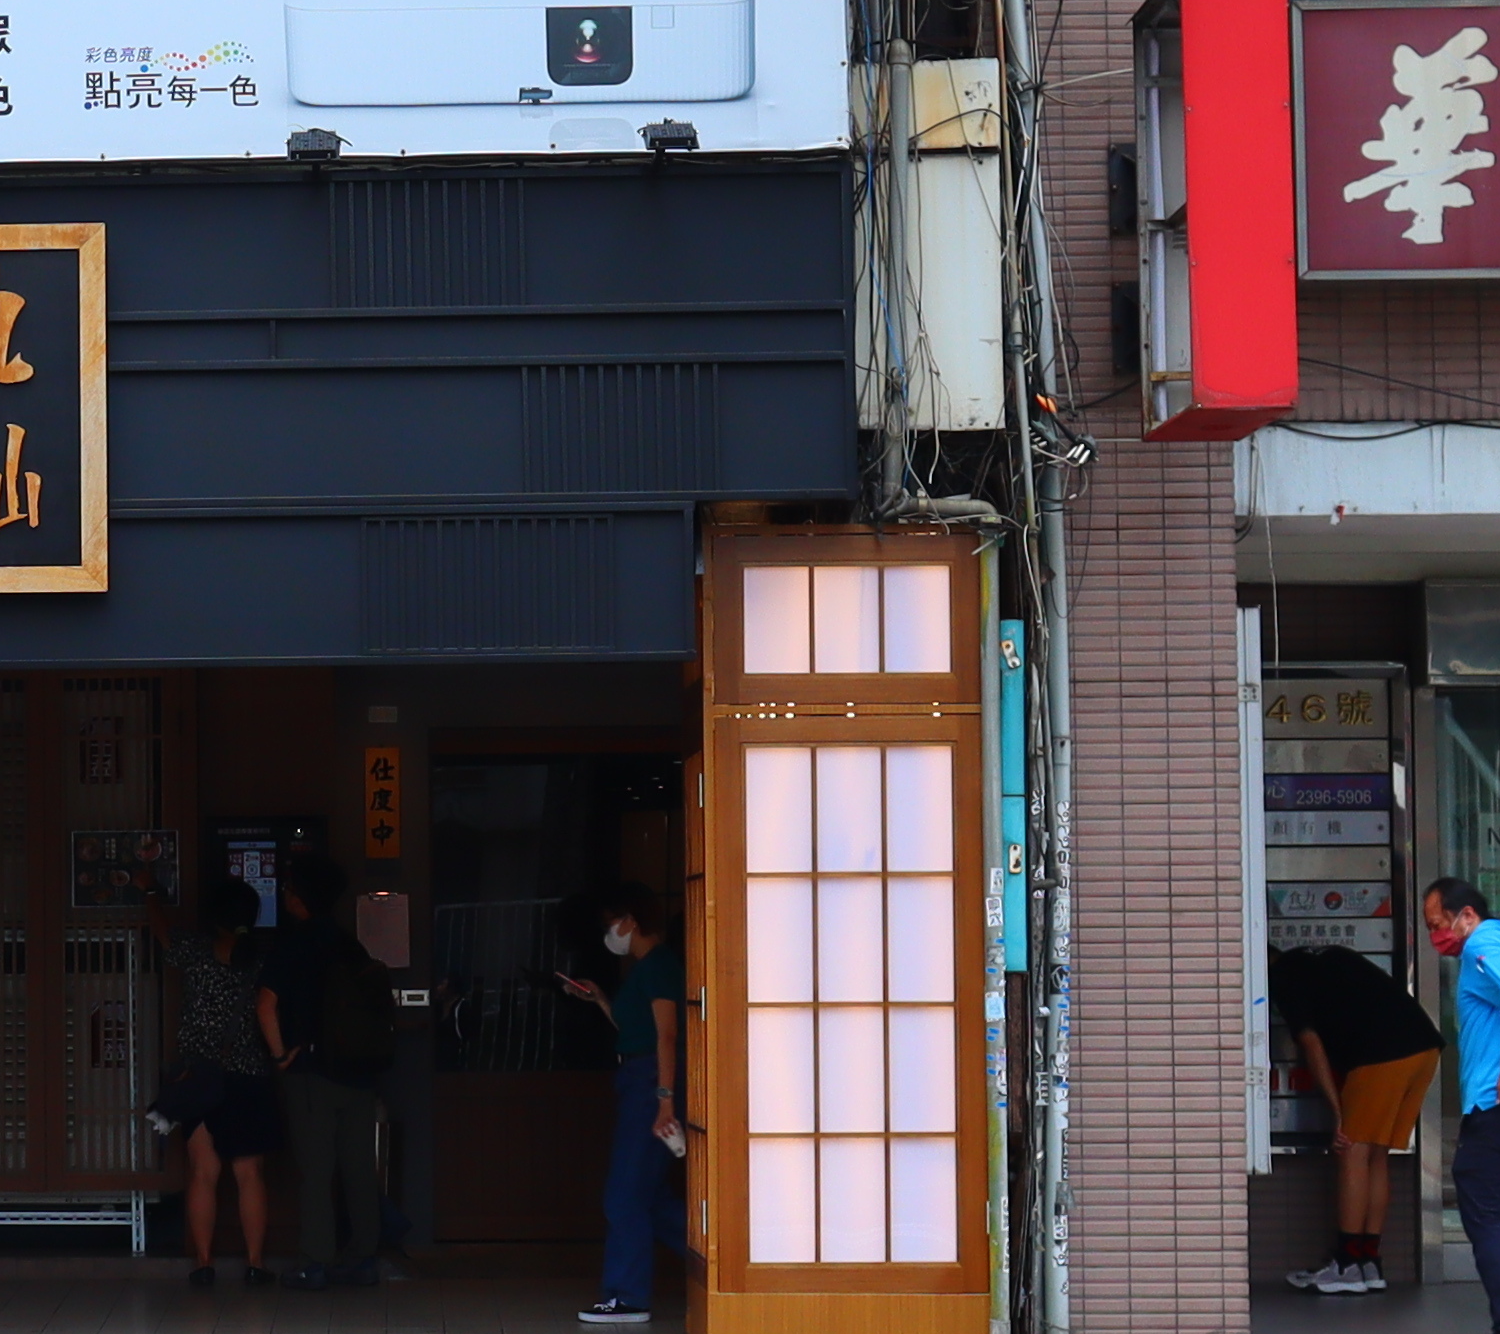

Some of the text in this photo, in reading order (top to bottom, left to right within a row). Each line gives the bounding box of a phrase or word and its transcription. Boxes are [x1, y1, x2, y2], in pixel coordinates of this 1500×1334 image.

[84, 45, 154, 65] 彩色亮度
[83, 70, 260, 112] 點亮每一色
[1266, 690, 1374, 725] 46號
[1296, 789, 1372, 805] 2396-5906
